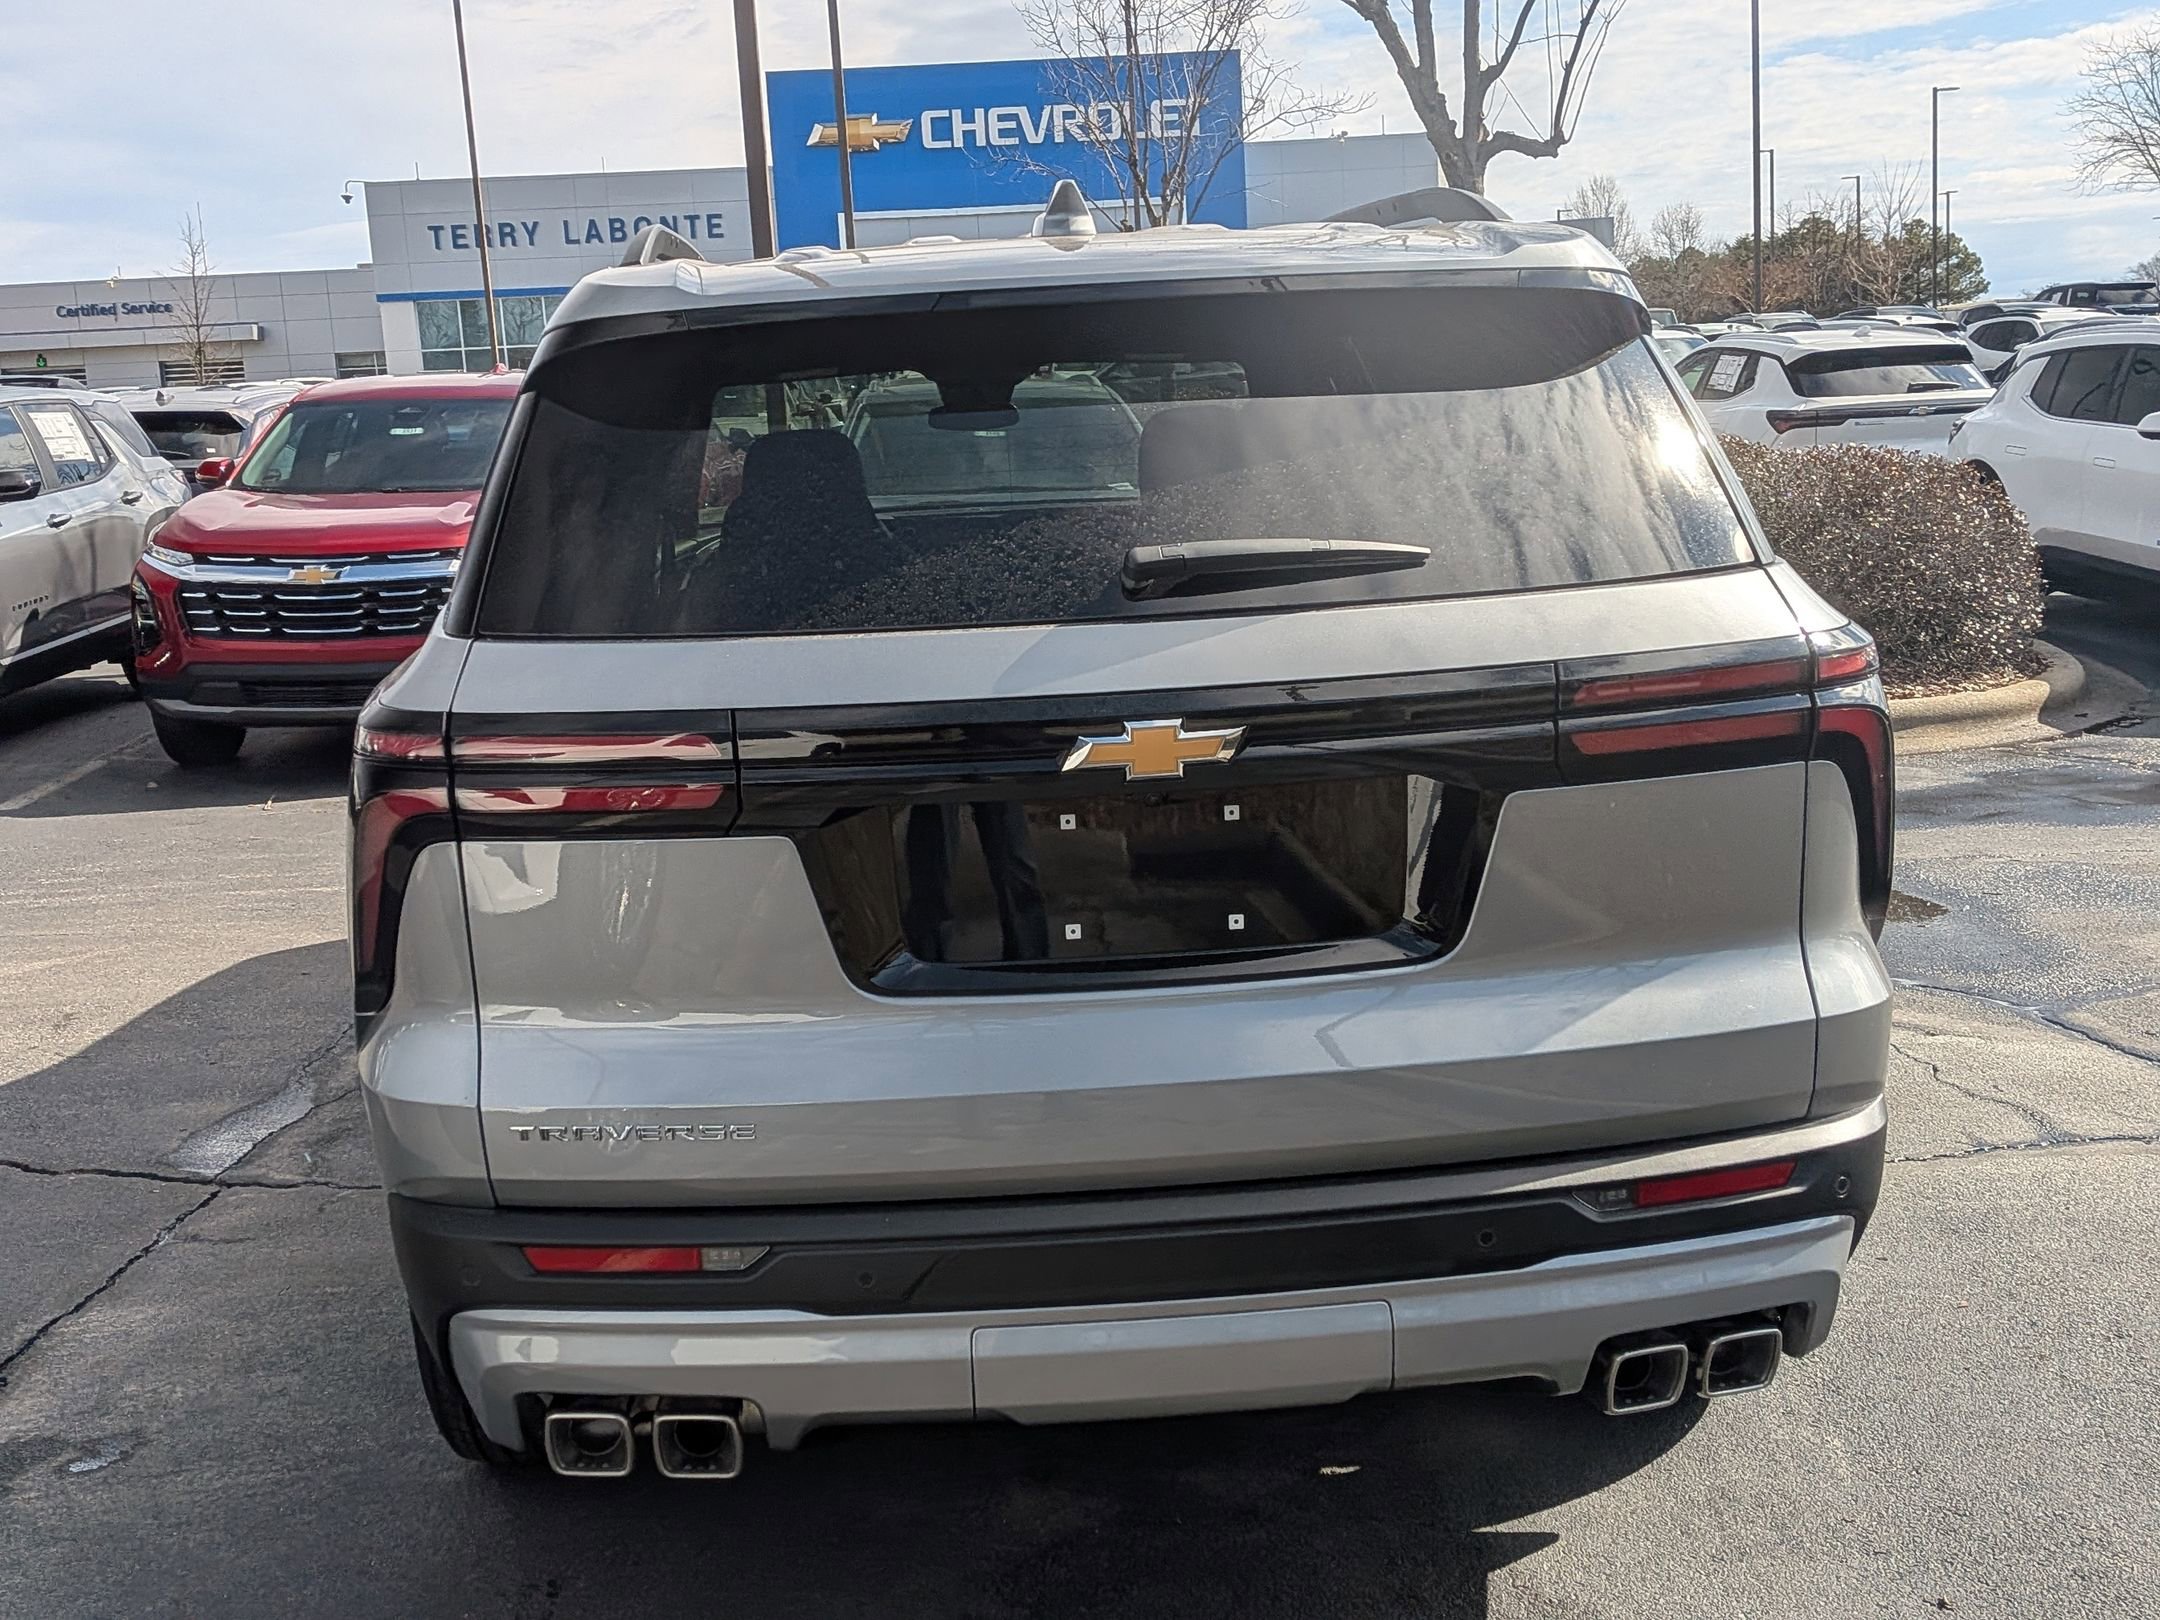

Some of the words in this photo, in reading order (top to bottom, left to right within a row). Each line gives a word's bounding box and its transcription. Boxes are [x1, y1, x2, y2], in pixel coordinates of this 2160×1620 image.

[921, 98, 1208, 149] CHEVROLET
[427, 221, 539, 250] TERRY
[563, 213, 725, 245] LABONTE
[56, 303, 117, 318] Certified
[121, 302, 174, 315] Service
[509, 1124, 757, 1142] TRAVERSE
